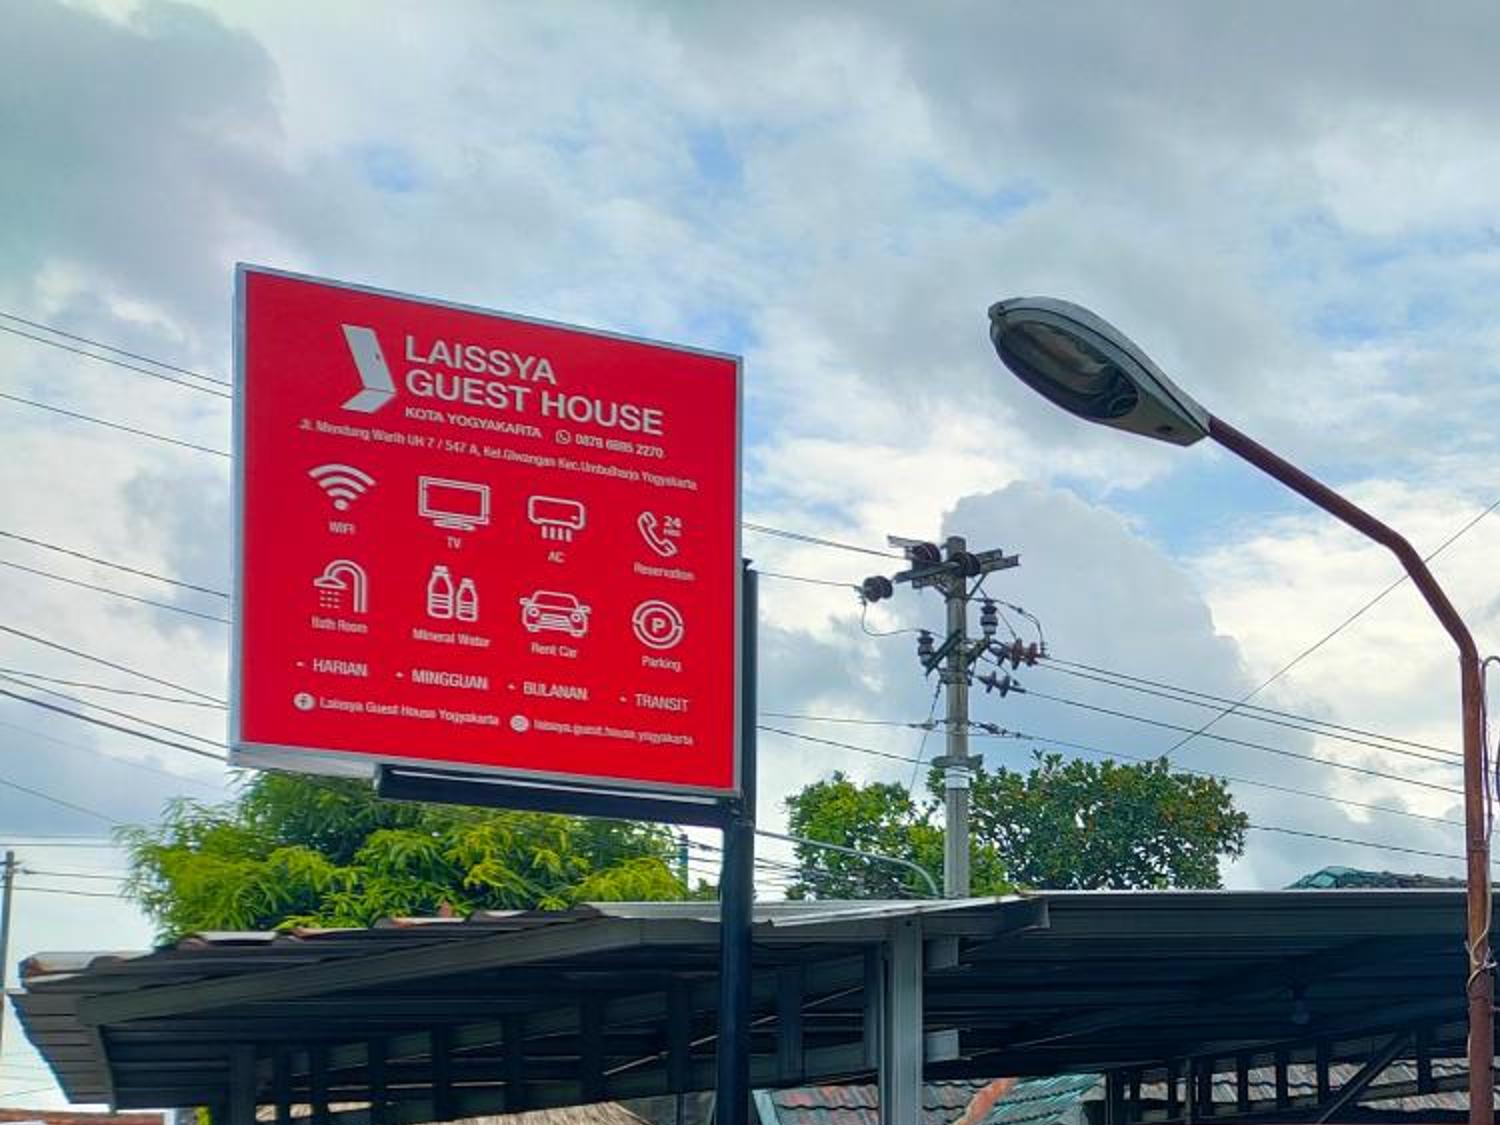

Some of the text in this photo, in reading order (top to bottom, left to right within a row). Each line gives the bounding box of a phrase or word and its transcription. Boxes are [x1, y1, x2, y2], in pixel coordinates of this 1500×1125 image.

[405, 335, 557, 385] LAISSYA
[405, 368, 664, 436] GUEST HOUSE
[405, 406, 542, 438] KOTA YOGYAKARTA
[641, 471, 698, 491] Yogyakarta
[664, 516, 682, 528] 24
[448, 536, 461, 549] TV
[548, 551, 565, 563] AC
[634, 562, 695, 581] Reservation
[311, 615, 368, 634] Bath Room
[652, 618, 665, 633] P
[412, 627, 491, 648] Mineral Water
[531, 642, 577, 659] Rent Car
[313, 657, 368, 677] HARIAN
[641, 655, 682, 673] Parking
[411, 668, 490, 690] MINGGUAN
[523, 681, 589, 701] BULANAN
[635, 693, 689, 712] TRANSIT
[366, 701, 398, 716] Guest
[401, 704, 437, 720] House
[438, 708, 499, 727] Yogyakarta
